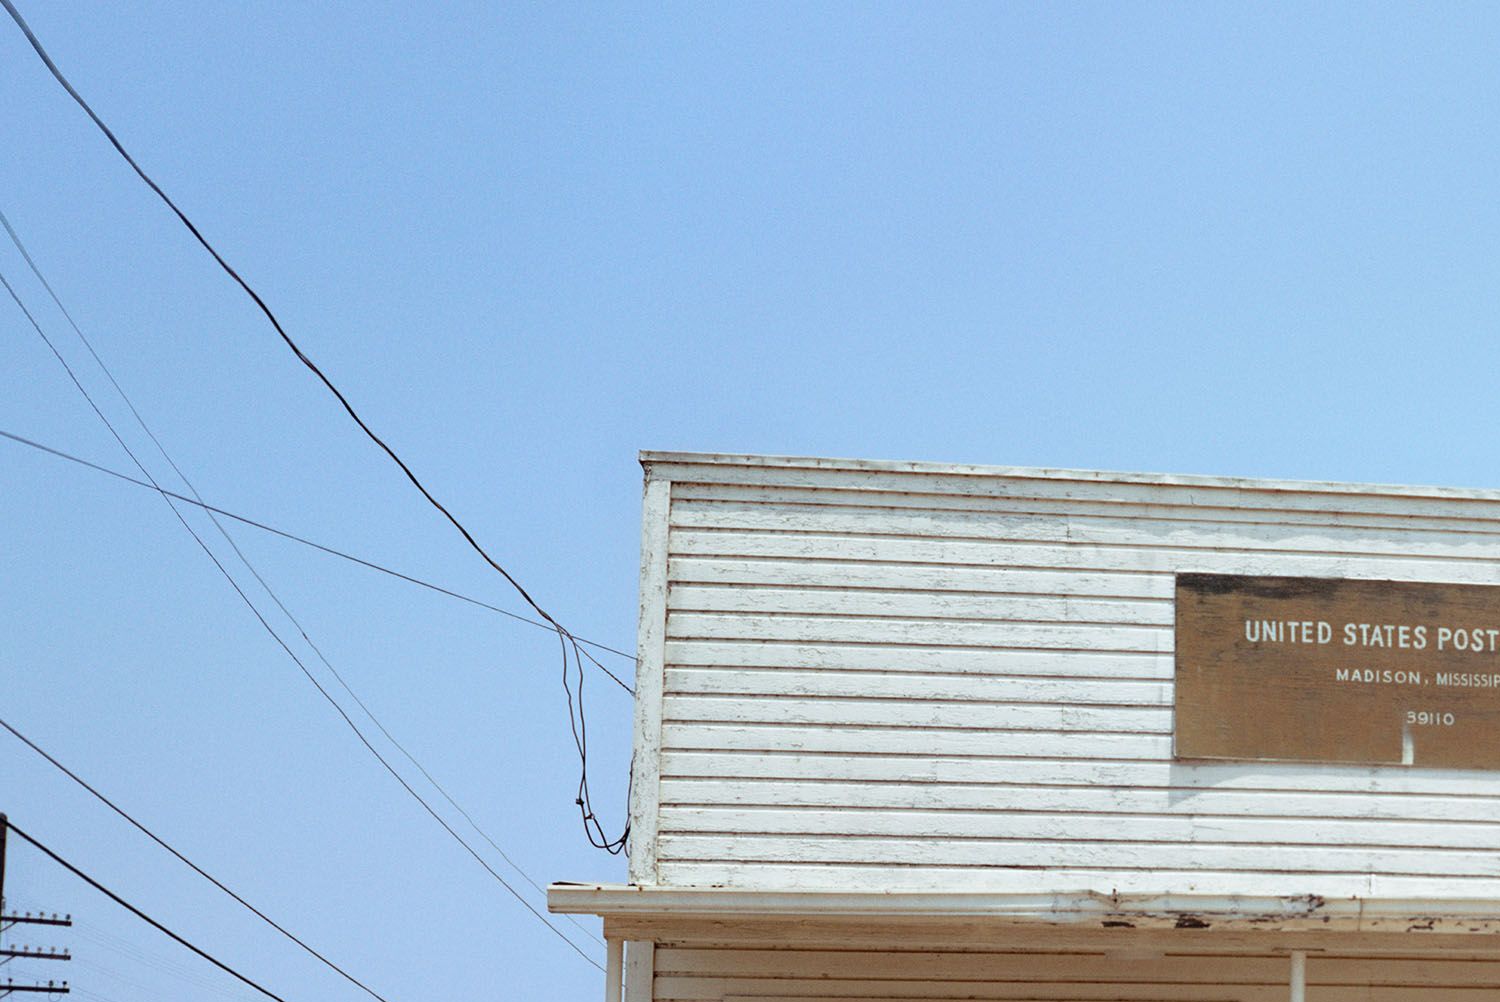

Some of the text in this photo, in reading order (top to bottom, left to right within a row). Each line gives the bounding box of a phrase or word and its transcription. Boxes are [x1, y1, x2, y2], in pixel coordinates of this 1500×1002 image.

[1246, 620, 1332, 644] UNITED
[1343, 623, 1427, 649] STATES
[1438, 627, 1499, 652] POST
[1336, 669, 1430, 685] MADISON,
[1406, 711, 1455, 726] 39110
